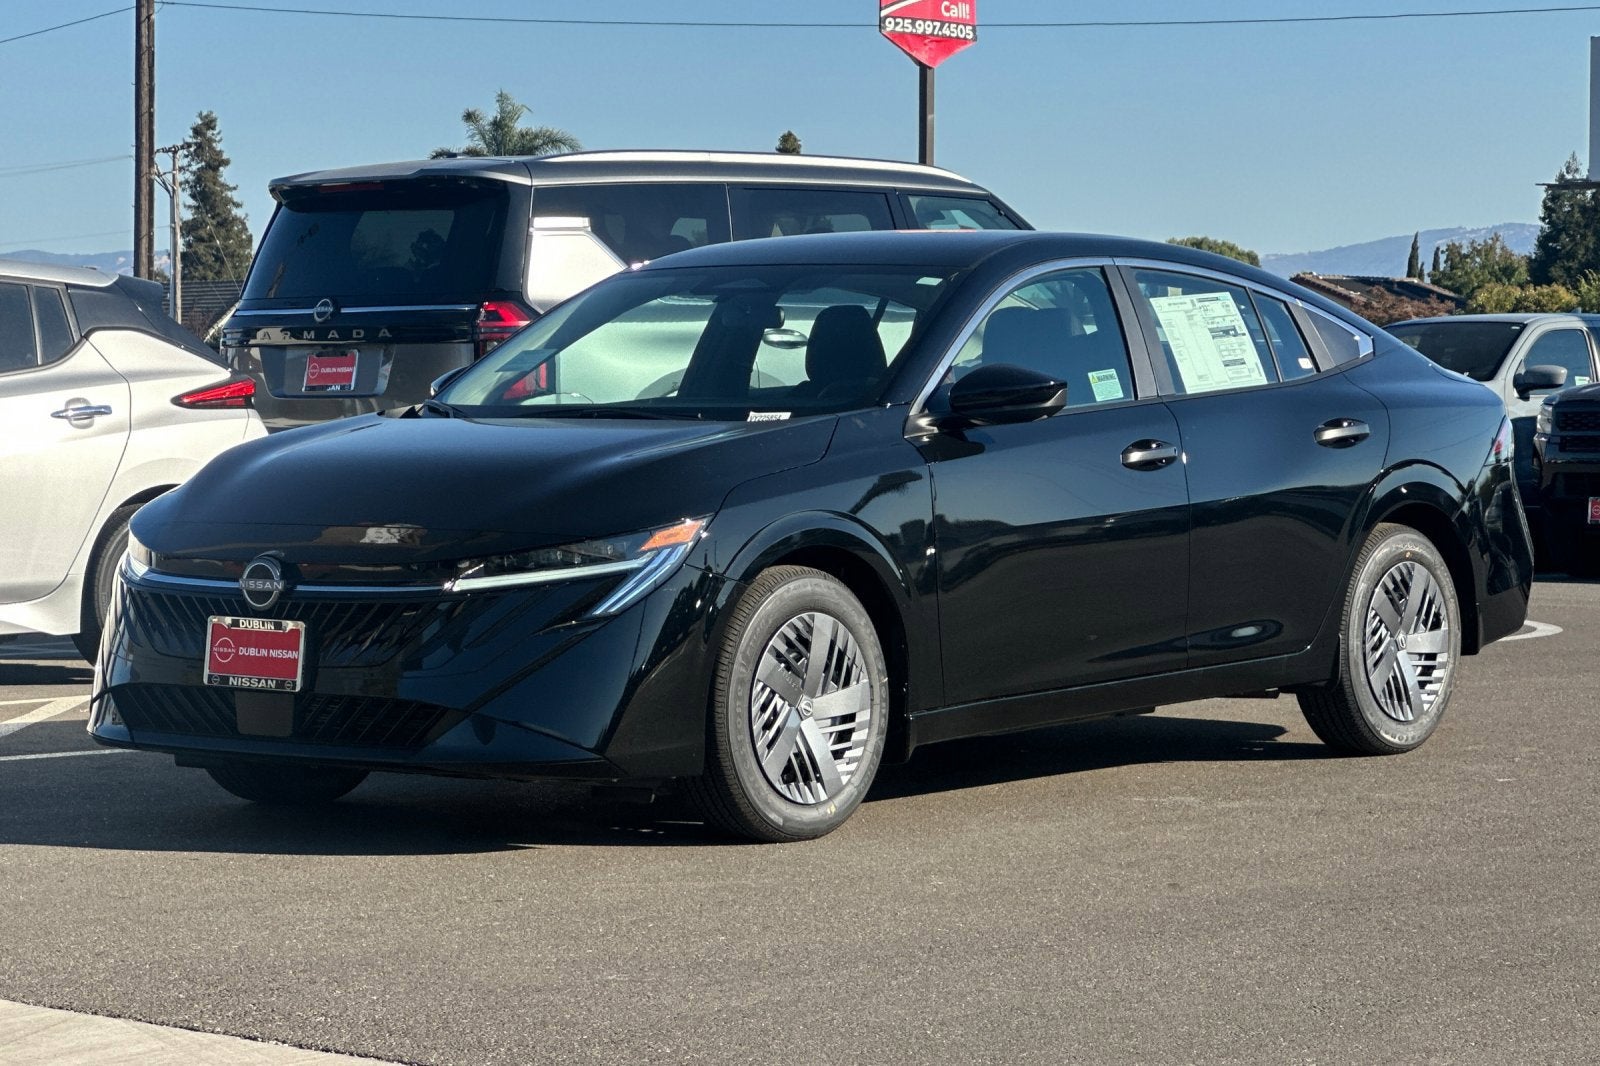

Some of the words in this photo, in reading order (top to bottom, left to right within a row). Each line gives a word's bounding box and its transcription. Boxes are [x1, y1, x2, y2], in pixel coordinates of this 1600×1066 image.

[941, 1, 970, 19] Call!
[885, 18, 974, 39] 925.997.4505
[260, 328, 393, 341] ARMADA
[240, 580, 282, 589] NISSAN
[240, 619, 275, 629] DUBLIN
[238, 647, 268, 657] DUBLIN
[269, 649, 299, 660] NISSAN
[229, 676, 276, 688] NISSAN
